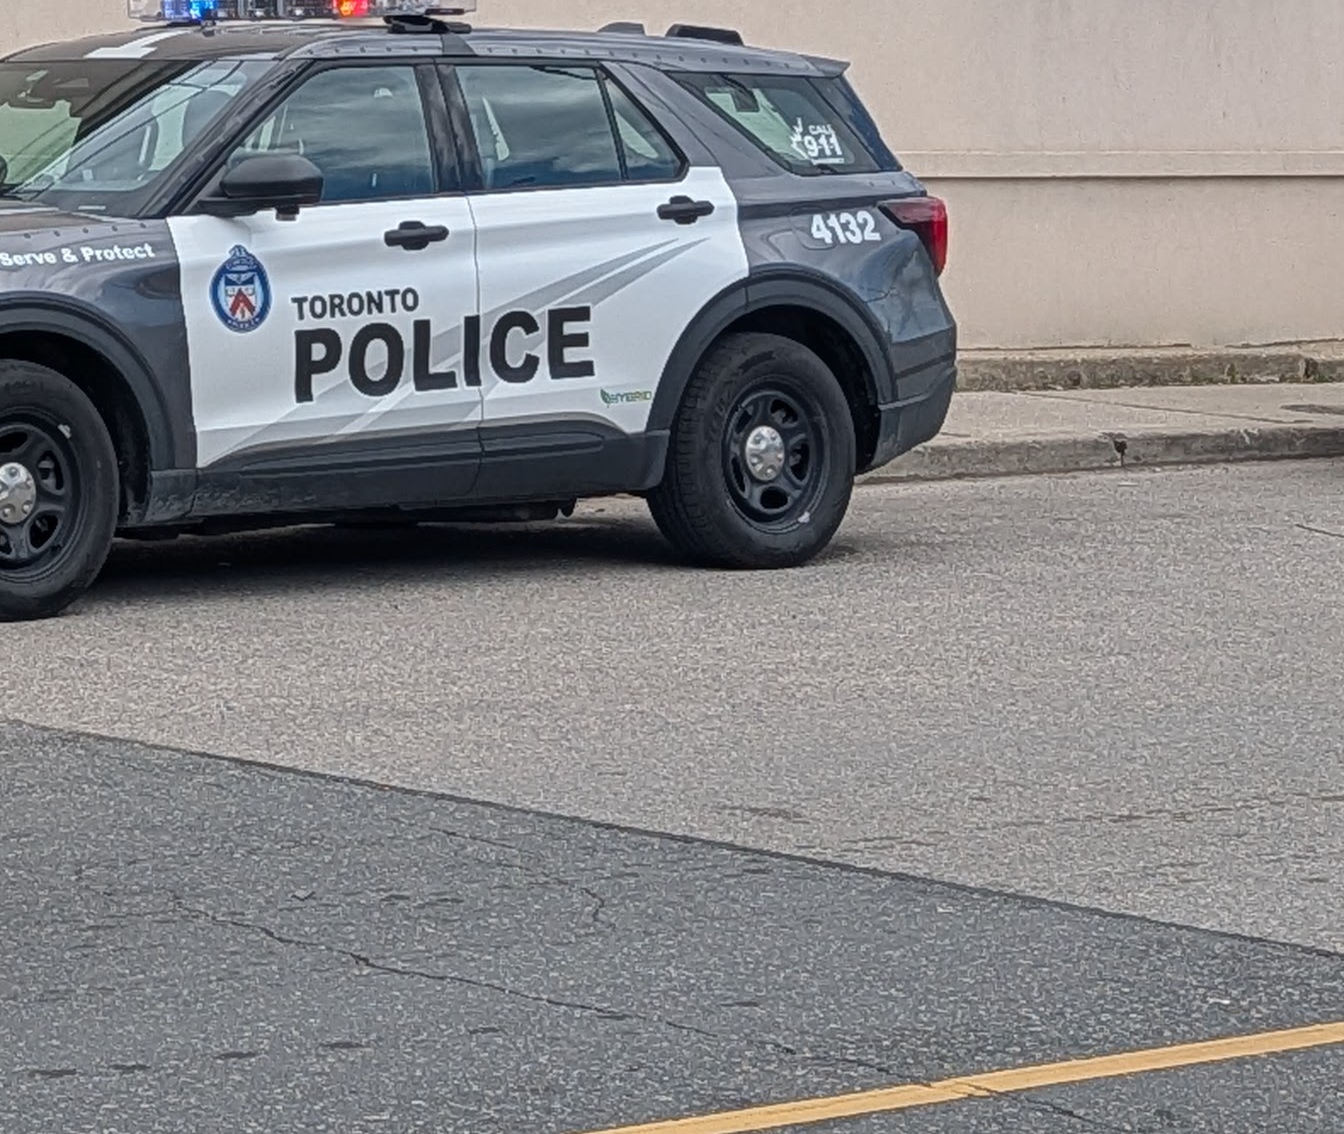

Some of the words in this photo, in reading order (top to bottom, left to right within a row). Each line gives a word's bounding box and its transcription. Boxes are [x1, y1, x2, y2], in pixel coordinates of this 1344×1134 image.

[811, 210, 882, 245] 4132
[61, 248, 78, 264] &
[80, 242, 156, 262] Protect
[291, 287, 419, 320] TORONTO
[293, 305, 596, 404] POLICE
